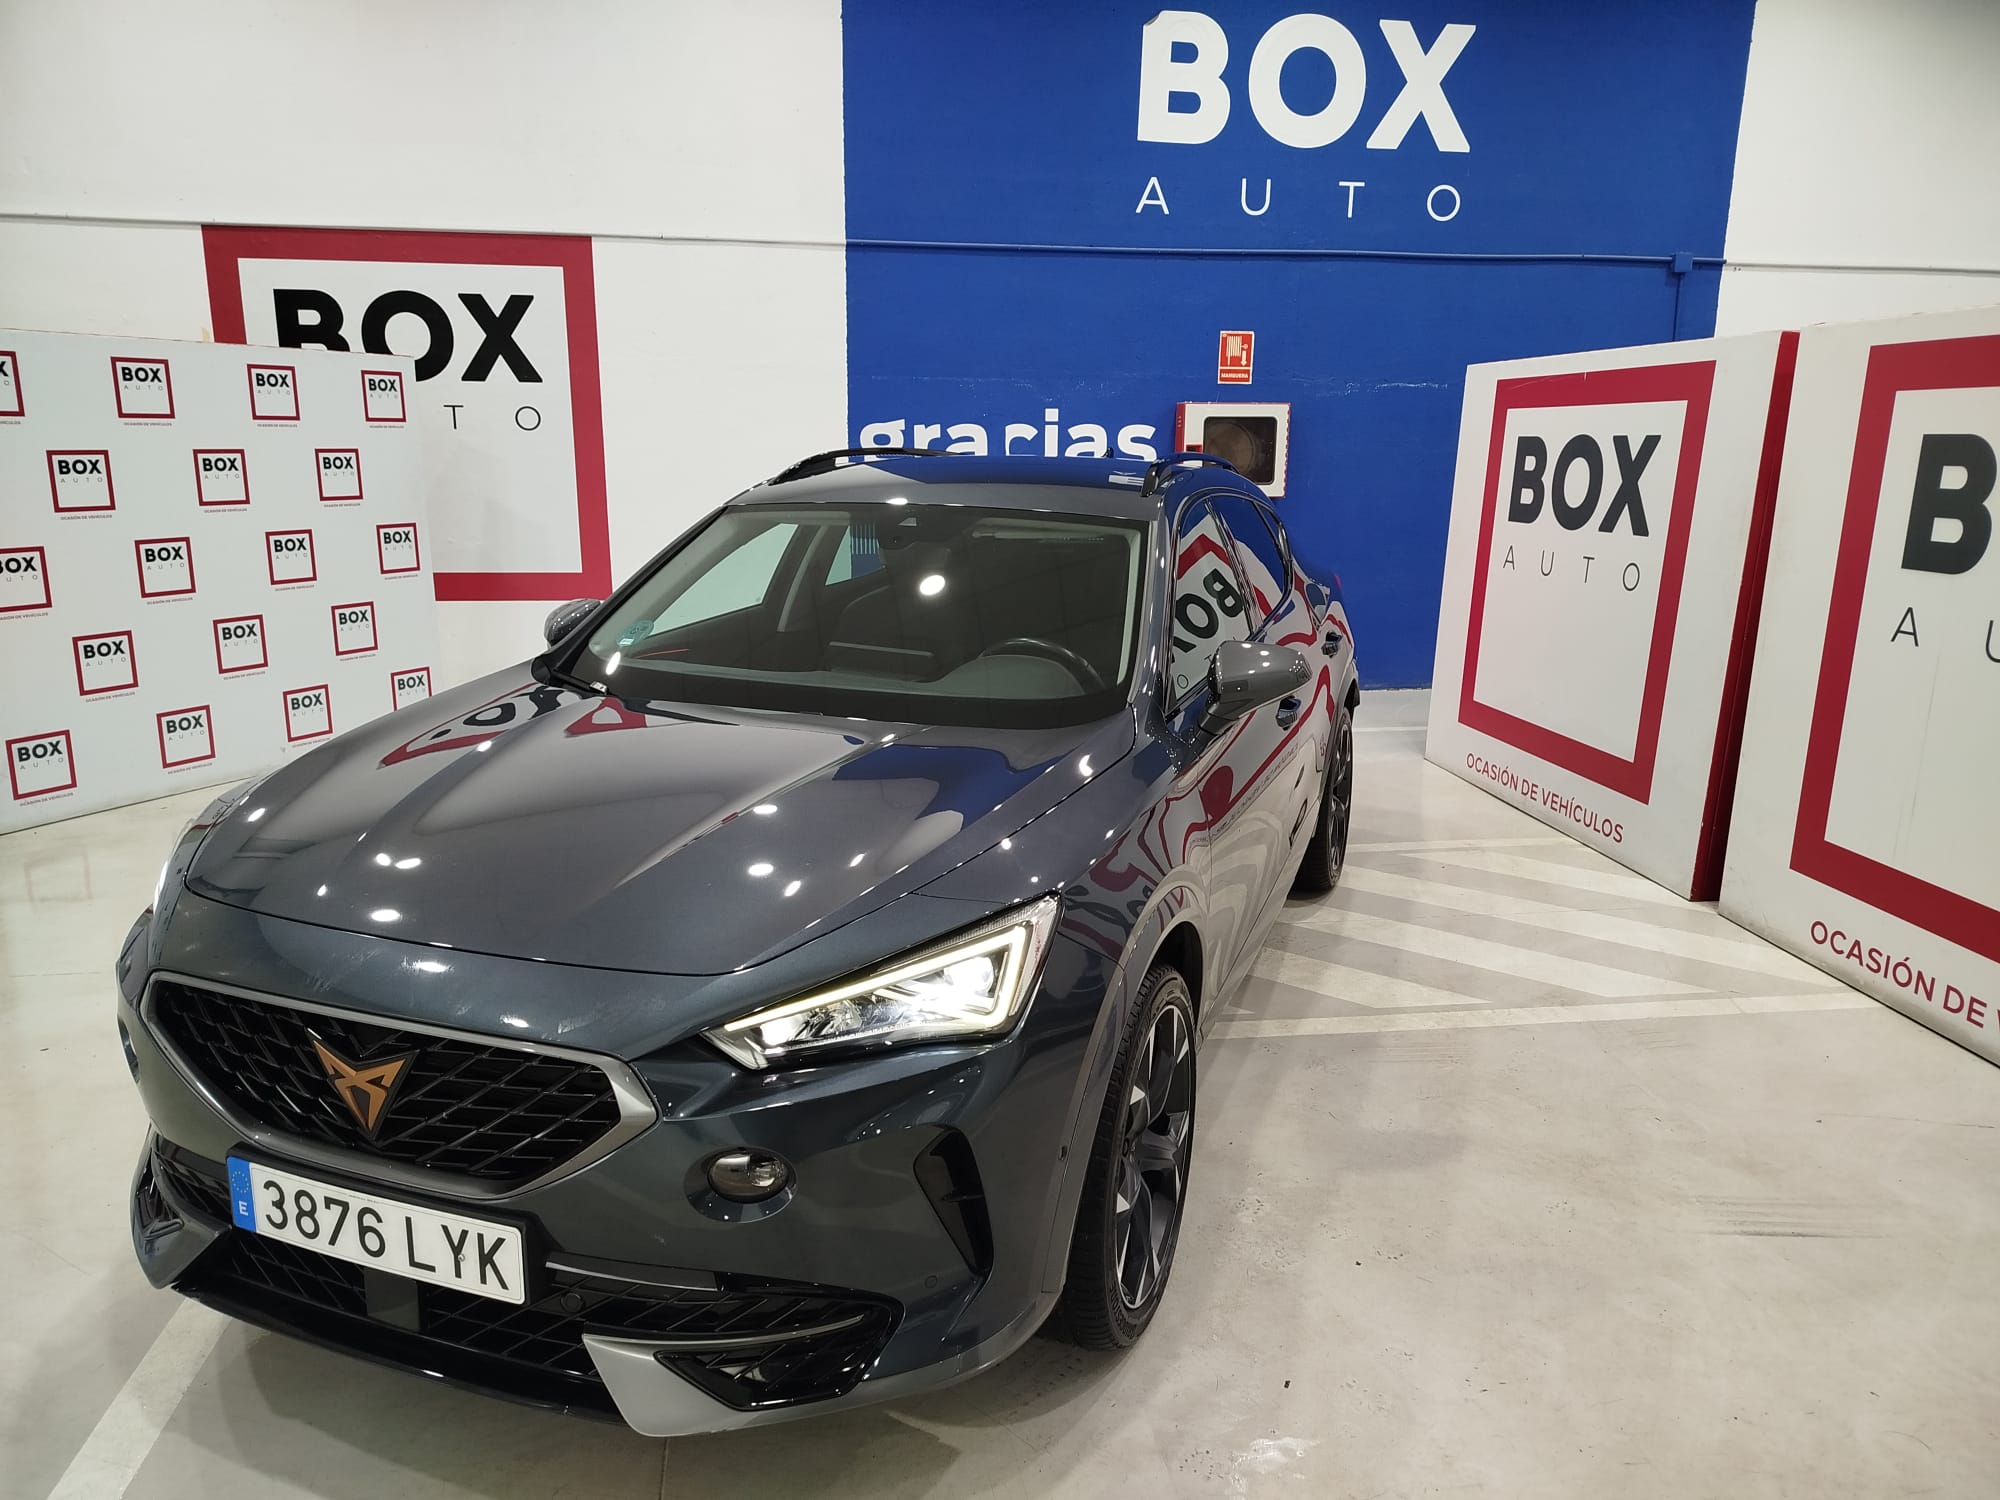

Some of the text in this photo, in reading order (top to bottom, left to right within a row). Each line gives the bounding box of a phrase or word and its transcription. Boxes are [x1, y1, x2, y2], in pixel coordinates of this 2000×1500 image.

[1137, 10, 1476, 153] BOX
[1135, 176, 1461, 222] AUTO
[273, 288, 543, 383] BOX
[121, 366, 162, 383] BOX
[256, 373, 289, 387] BOX
[368, 379, 397, 392] BOX
[859, 408, 1158, 463] gracias
[58, 459, 102, 474] BOX
[202, 458, 239, 471] BOX
[323, 457, 353, 469] BOX
[1508, 434, 1662, 537] BOX
[274, 538, 307, 552] BOX
[383, 531, 412, 544] BOX
[145, 546, 184, 562] BOX
[1502, 545, 1641, 592] AUTO
[338, 610, 369, 625] BOX
[221, 623, 257, 640] BOX
[83, 640, 125, 659] BOX
[397, 674, 425, 691] BOX
[291, 693, 323, 710] BOX
[166, 714, 204, 734] BOX
[17, 740, 62, 762] BOX
[1466, 752, 1624, 844] OCASIÓN DE VEHÍCULOS
[1810, 920, 1988, 1029] OCASIÓN DE
[238, 1201, 248, 1216] E
[263, 1179, 510, 1291] 3876 LYK
